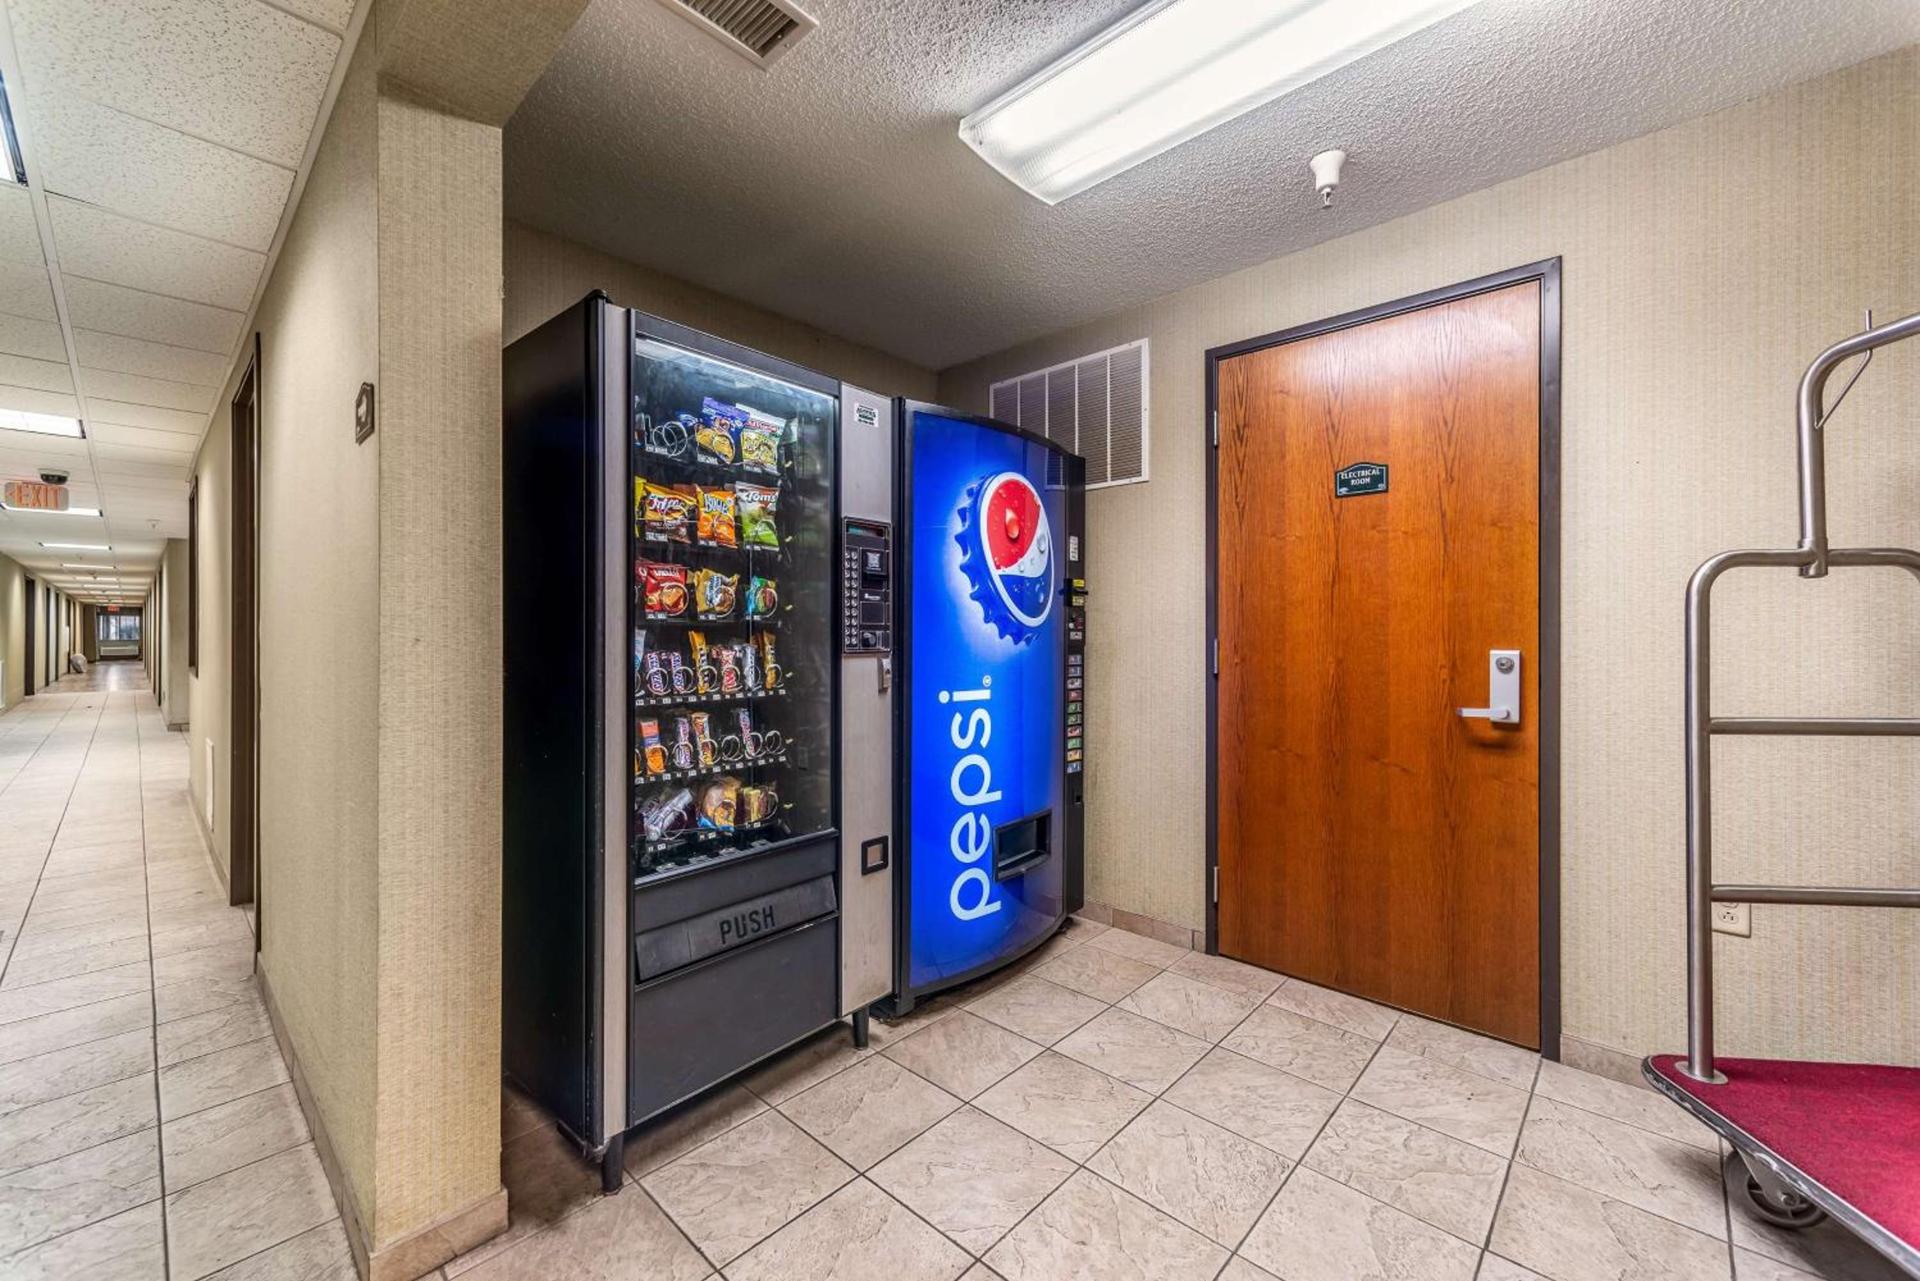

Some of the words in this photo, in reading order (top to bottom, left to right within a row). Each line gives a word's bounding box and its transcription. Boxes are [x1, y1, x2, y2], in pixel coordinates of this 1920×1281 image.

[1340, 468, 1381, 480] ELECTRICAL
[1351, 477, 1371, 486] ROOM
[16, 483, 62, 509] EXIT
[938, 688, 1002, 921] pepsi
[719, 904, 776, 945] PUSH
